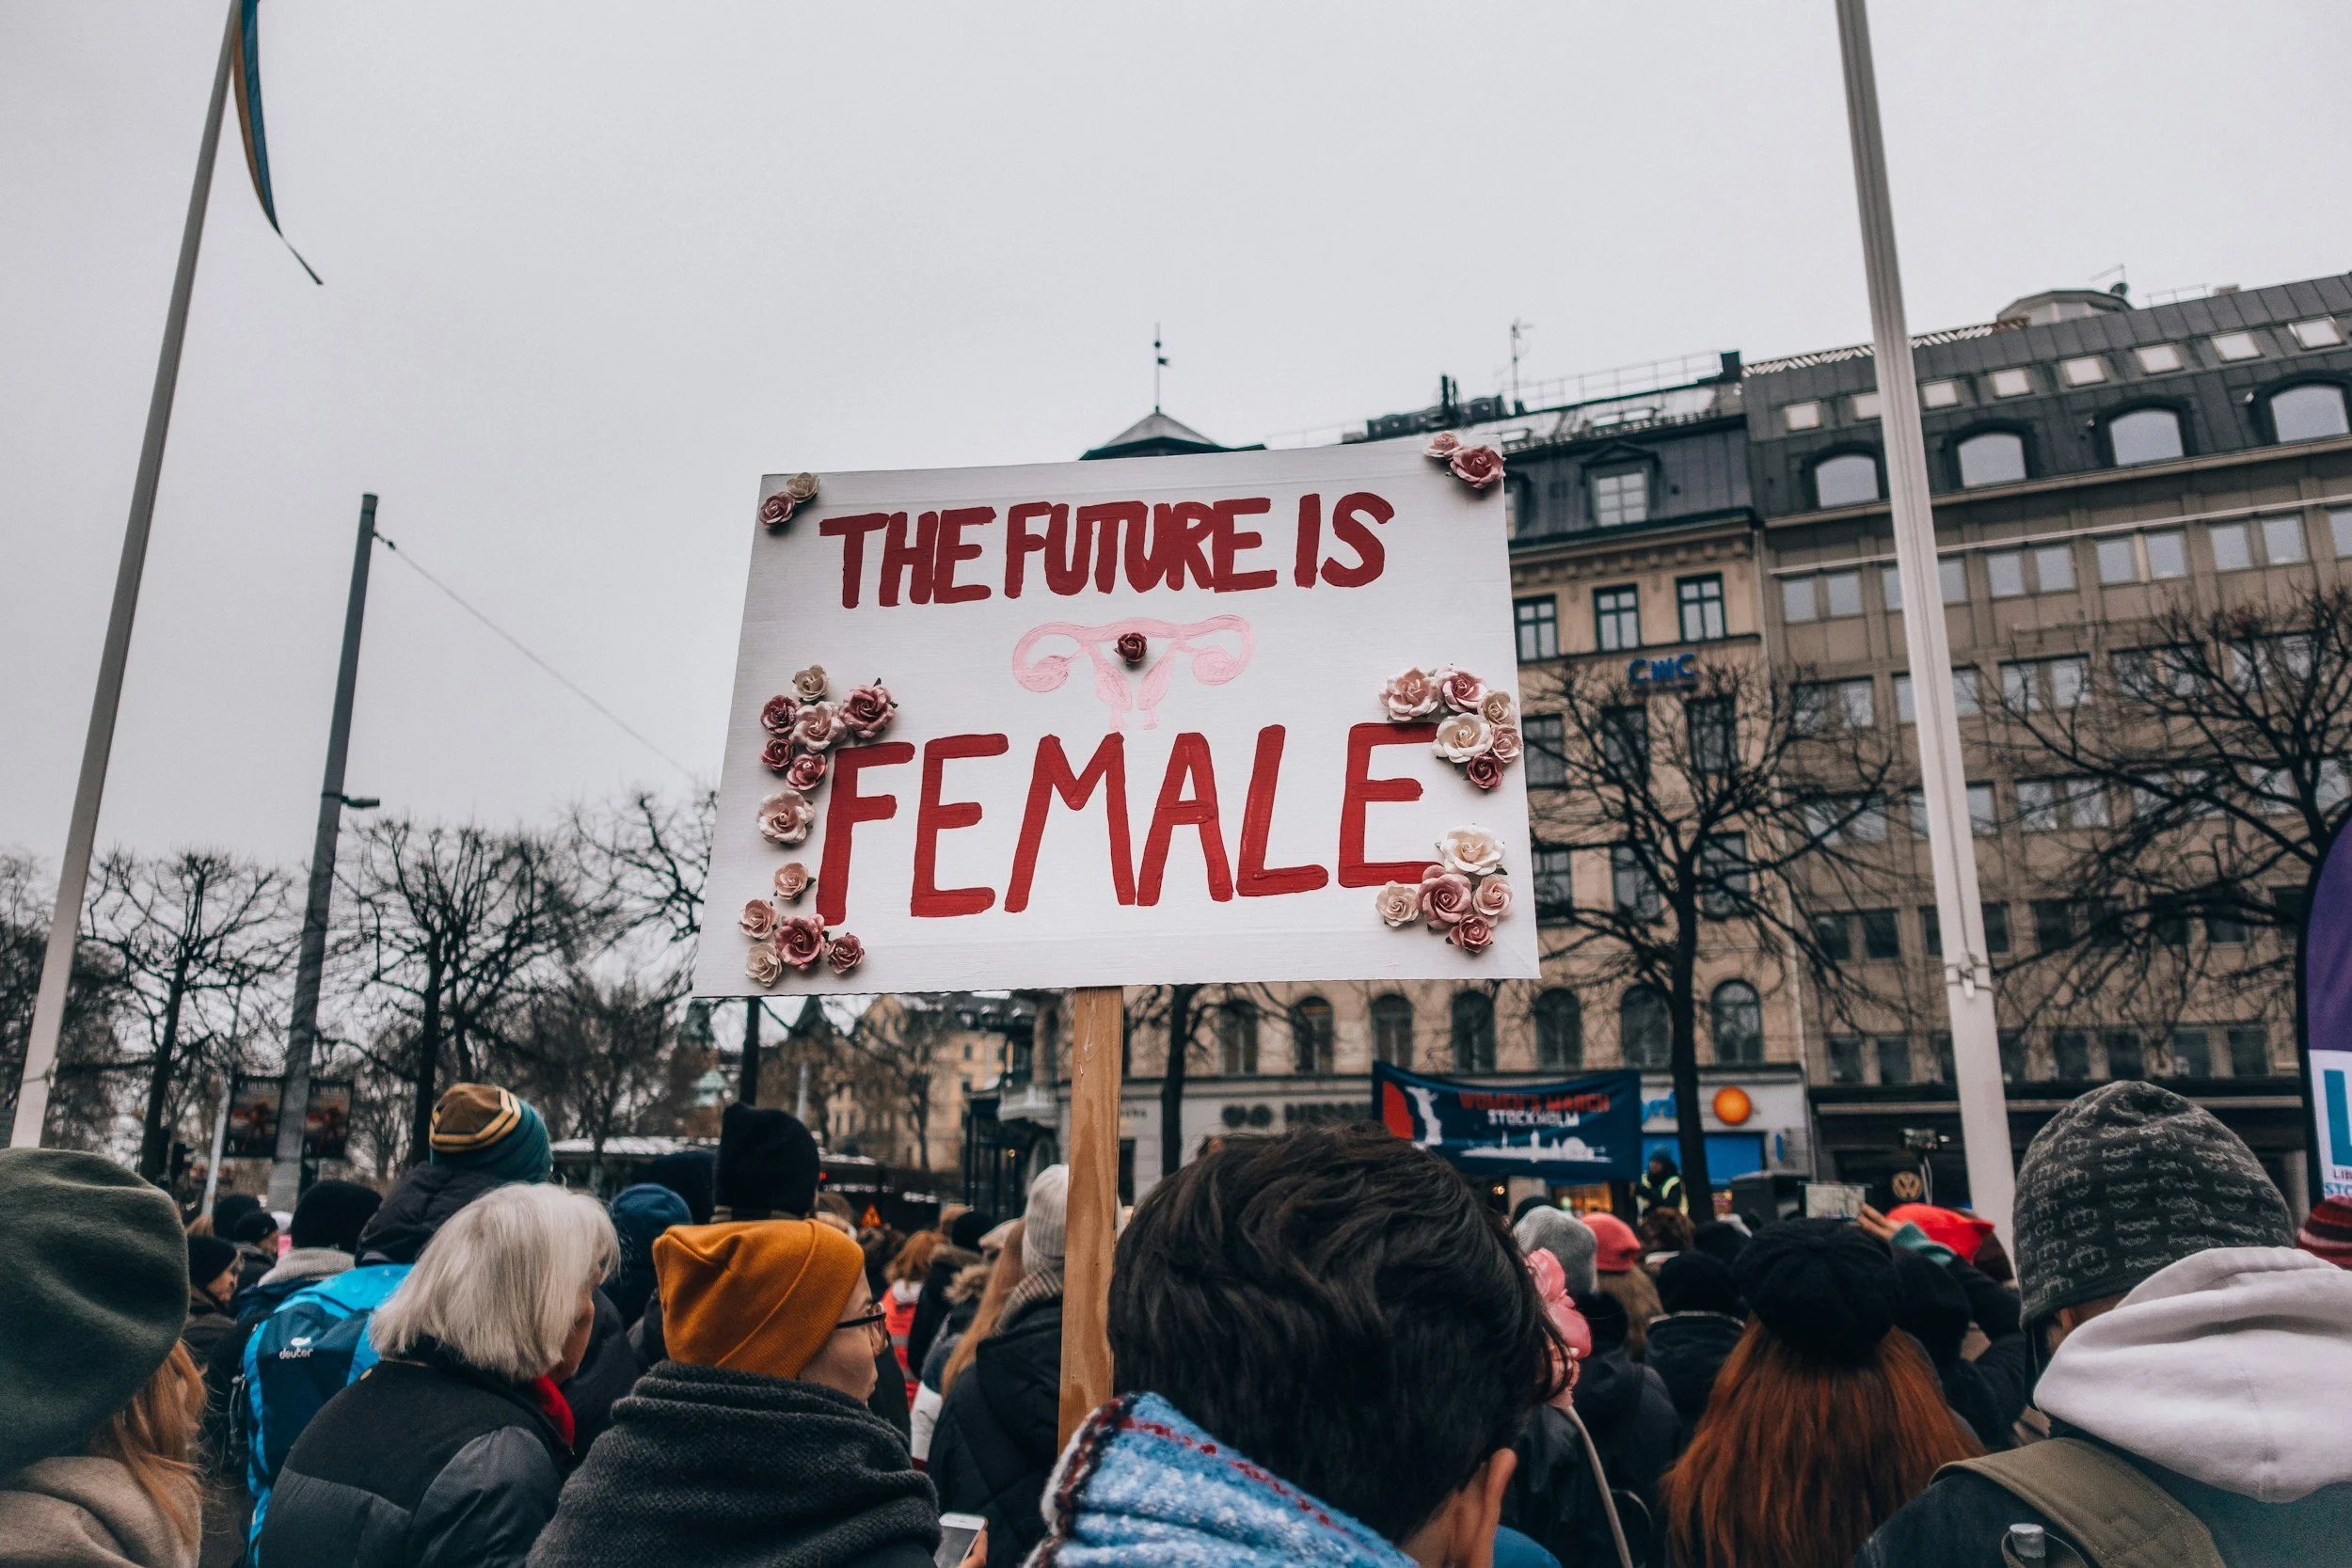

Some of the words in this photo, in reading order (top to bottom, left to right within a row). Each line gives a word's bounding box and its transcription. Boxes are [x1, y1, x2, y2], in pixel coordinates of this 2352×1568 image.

[819, 506, 996, 610] THE
[1003, 498, 1278, 599] FUTURE
[1294, 491, 1395, 588] IS
[817, 722, 1439, 926] FEMALE
[1486, 1108, 1580, 1127] STOCKHOLM
[279, 1347, 314, 1360] deuter
